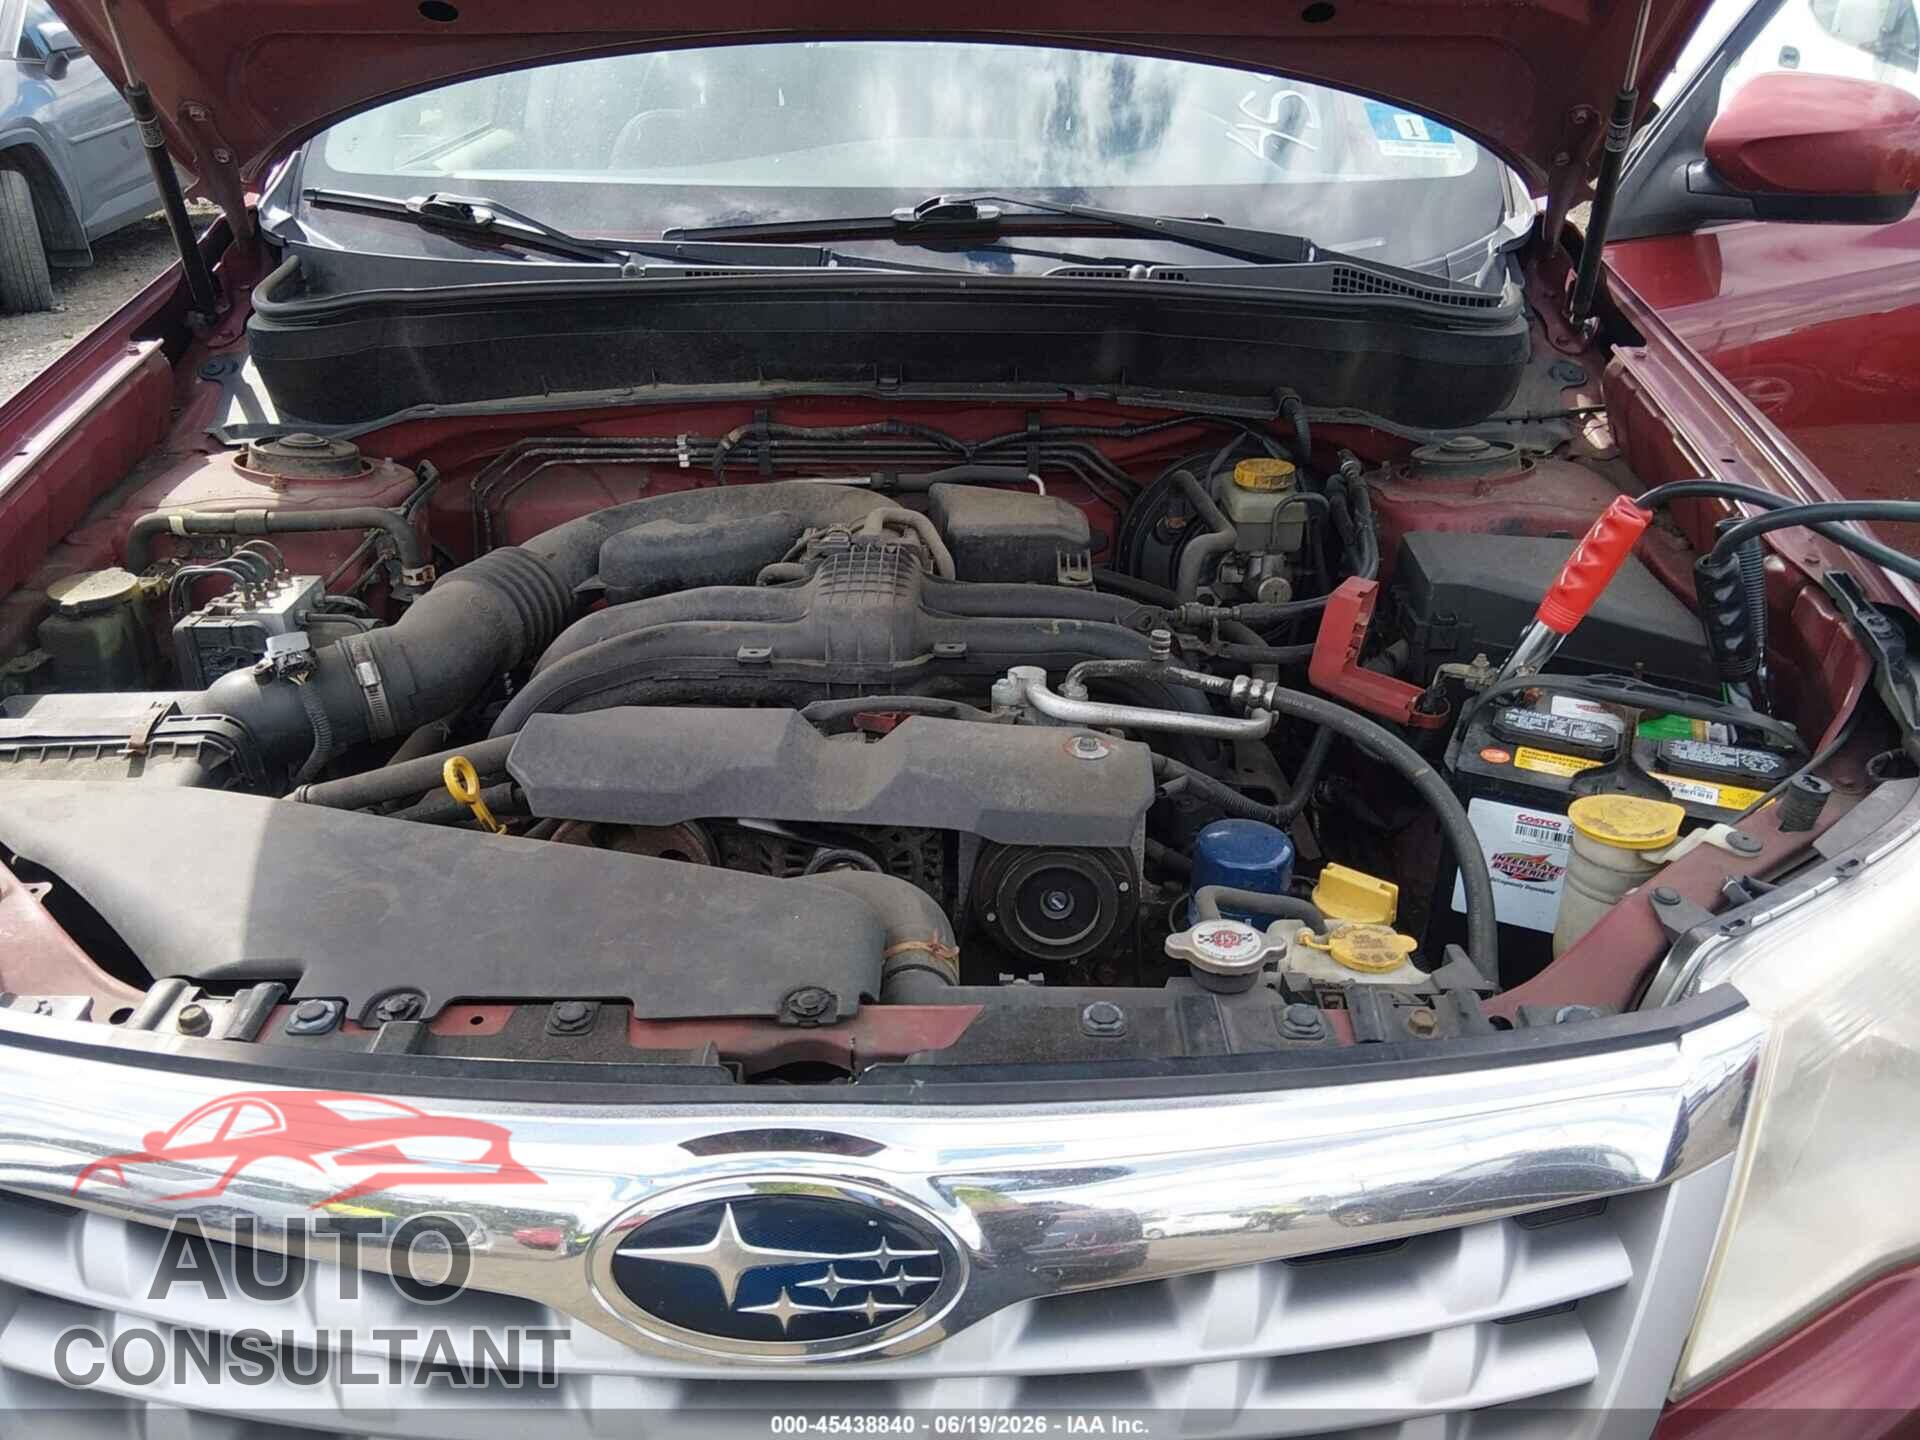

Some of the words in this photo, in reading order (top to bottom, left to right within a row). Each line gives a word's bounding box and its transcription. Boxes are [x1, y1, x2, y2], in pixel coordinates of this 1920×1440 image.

[1405, 118, 1420, 137] 1
[1517, 813, 1562, 828] COSTCO
[1492, 853, 1565, 873] INTERSTATE
[1492, 863, 1557, 880] BATTERIES
